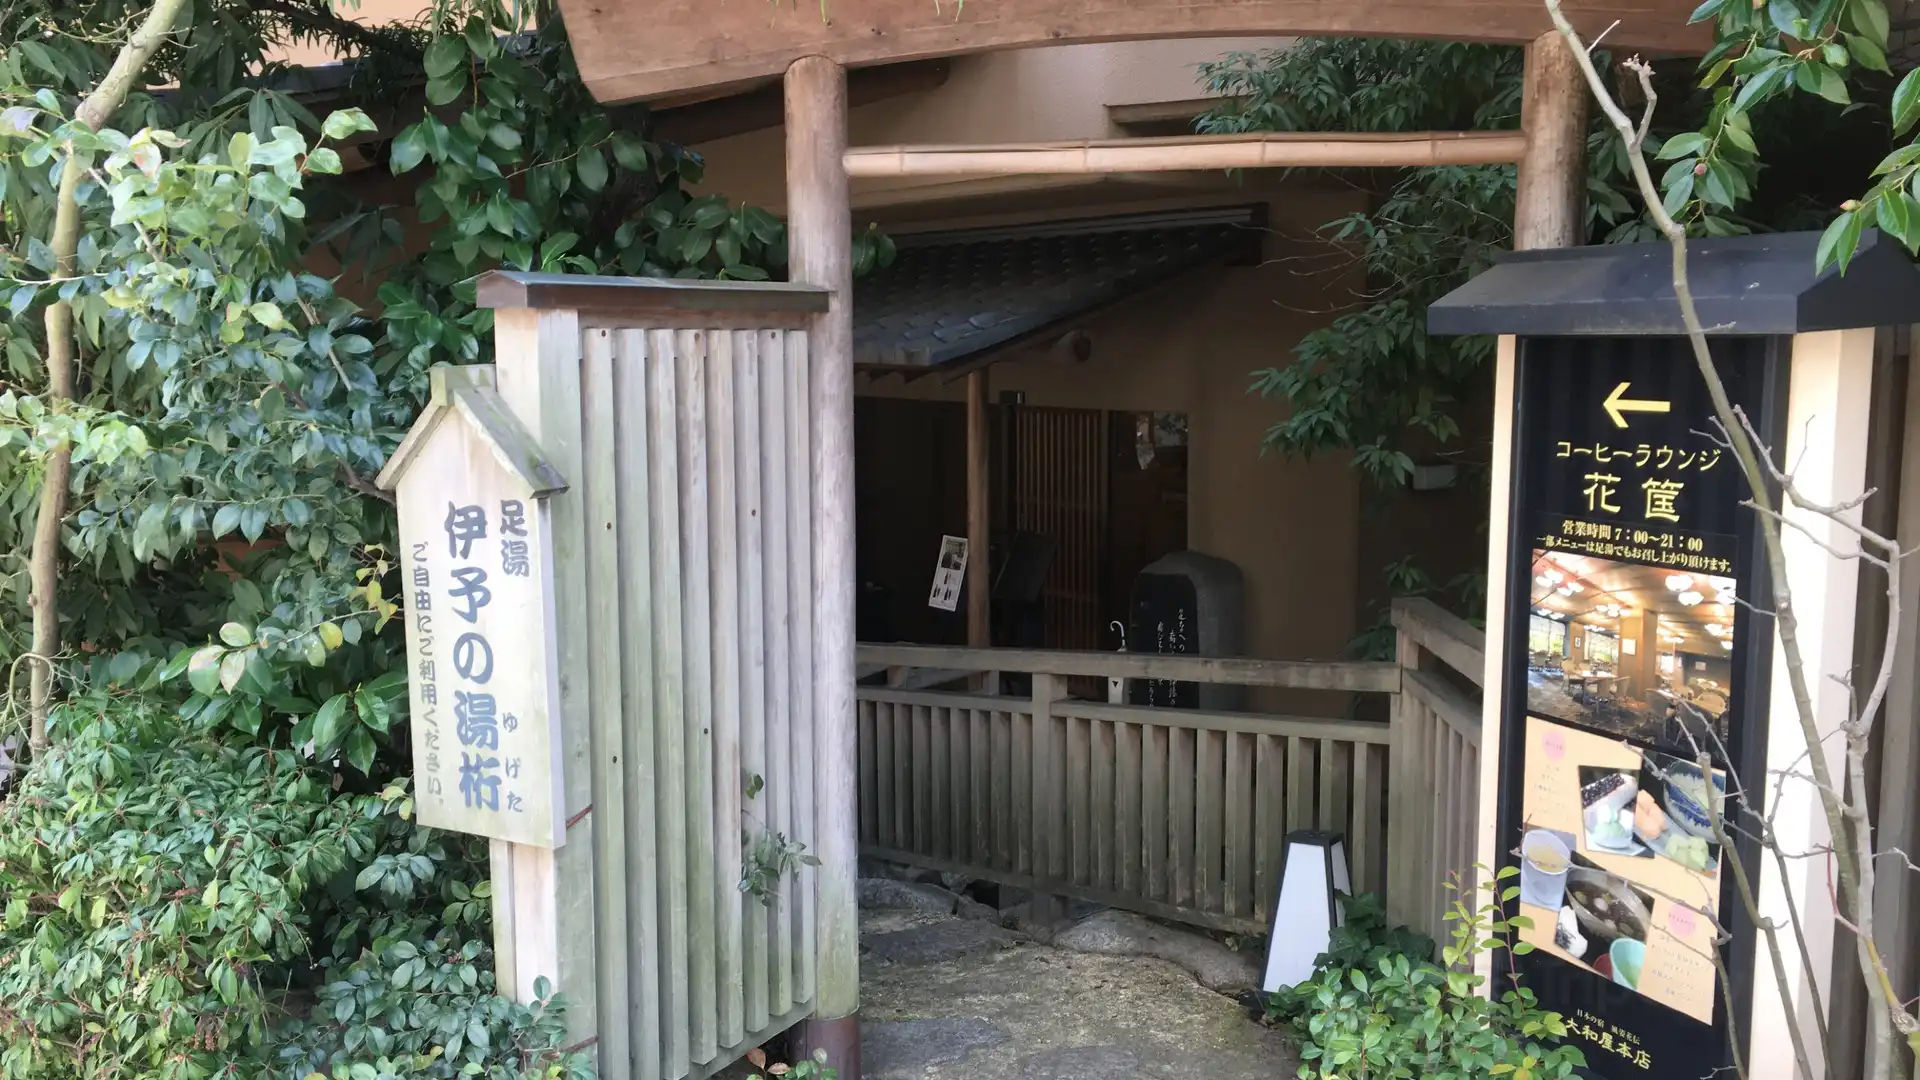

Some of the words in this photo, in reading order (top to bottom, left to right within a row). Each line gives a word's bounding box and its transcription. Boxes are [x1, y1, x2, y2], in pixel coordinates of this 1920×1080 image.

[1556, 441, 1721, 472] コーヒーラウンジ
[500, 499, 530, 578] 足湯
[1562, 520, 1611, 541] 営業時間
[444, 500, 502, 813] 伊予の湯桁
[502, 711, 524, 813] ゆげた
[1565, 1017, 1652, 1071] 大和屋本店
[1576, 1008, 1605, 1030] 日本の宿
